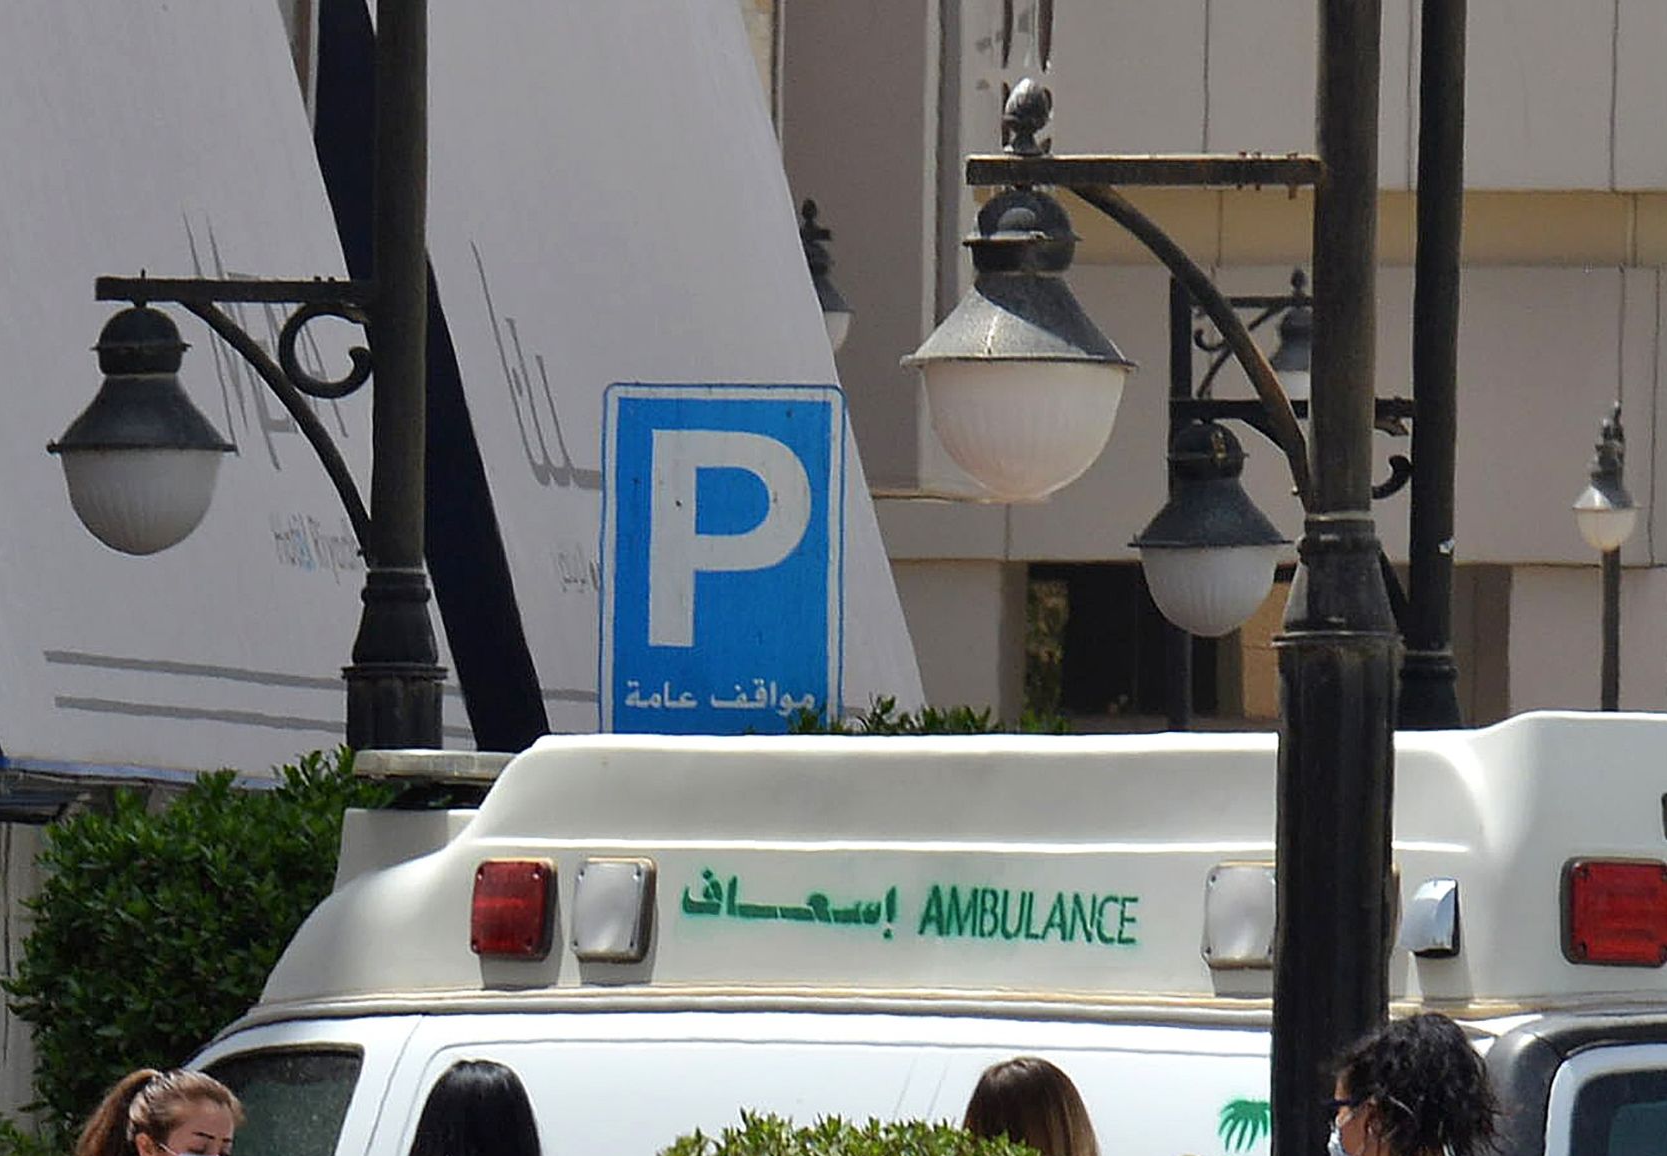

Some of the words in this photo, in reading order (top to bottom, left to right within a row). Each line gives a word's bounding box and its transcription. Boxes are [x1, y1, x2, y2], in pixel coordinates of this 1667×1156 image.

[649, 428, 812, 648] P
[624, 680, 698, 710] عامة
[710, 679, 816, 716] مواقف
[917, 883, 1139, 946] AMBULANCE
